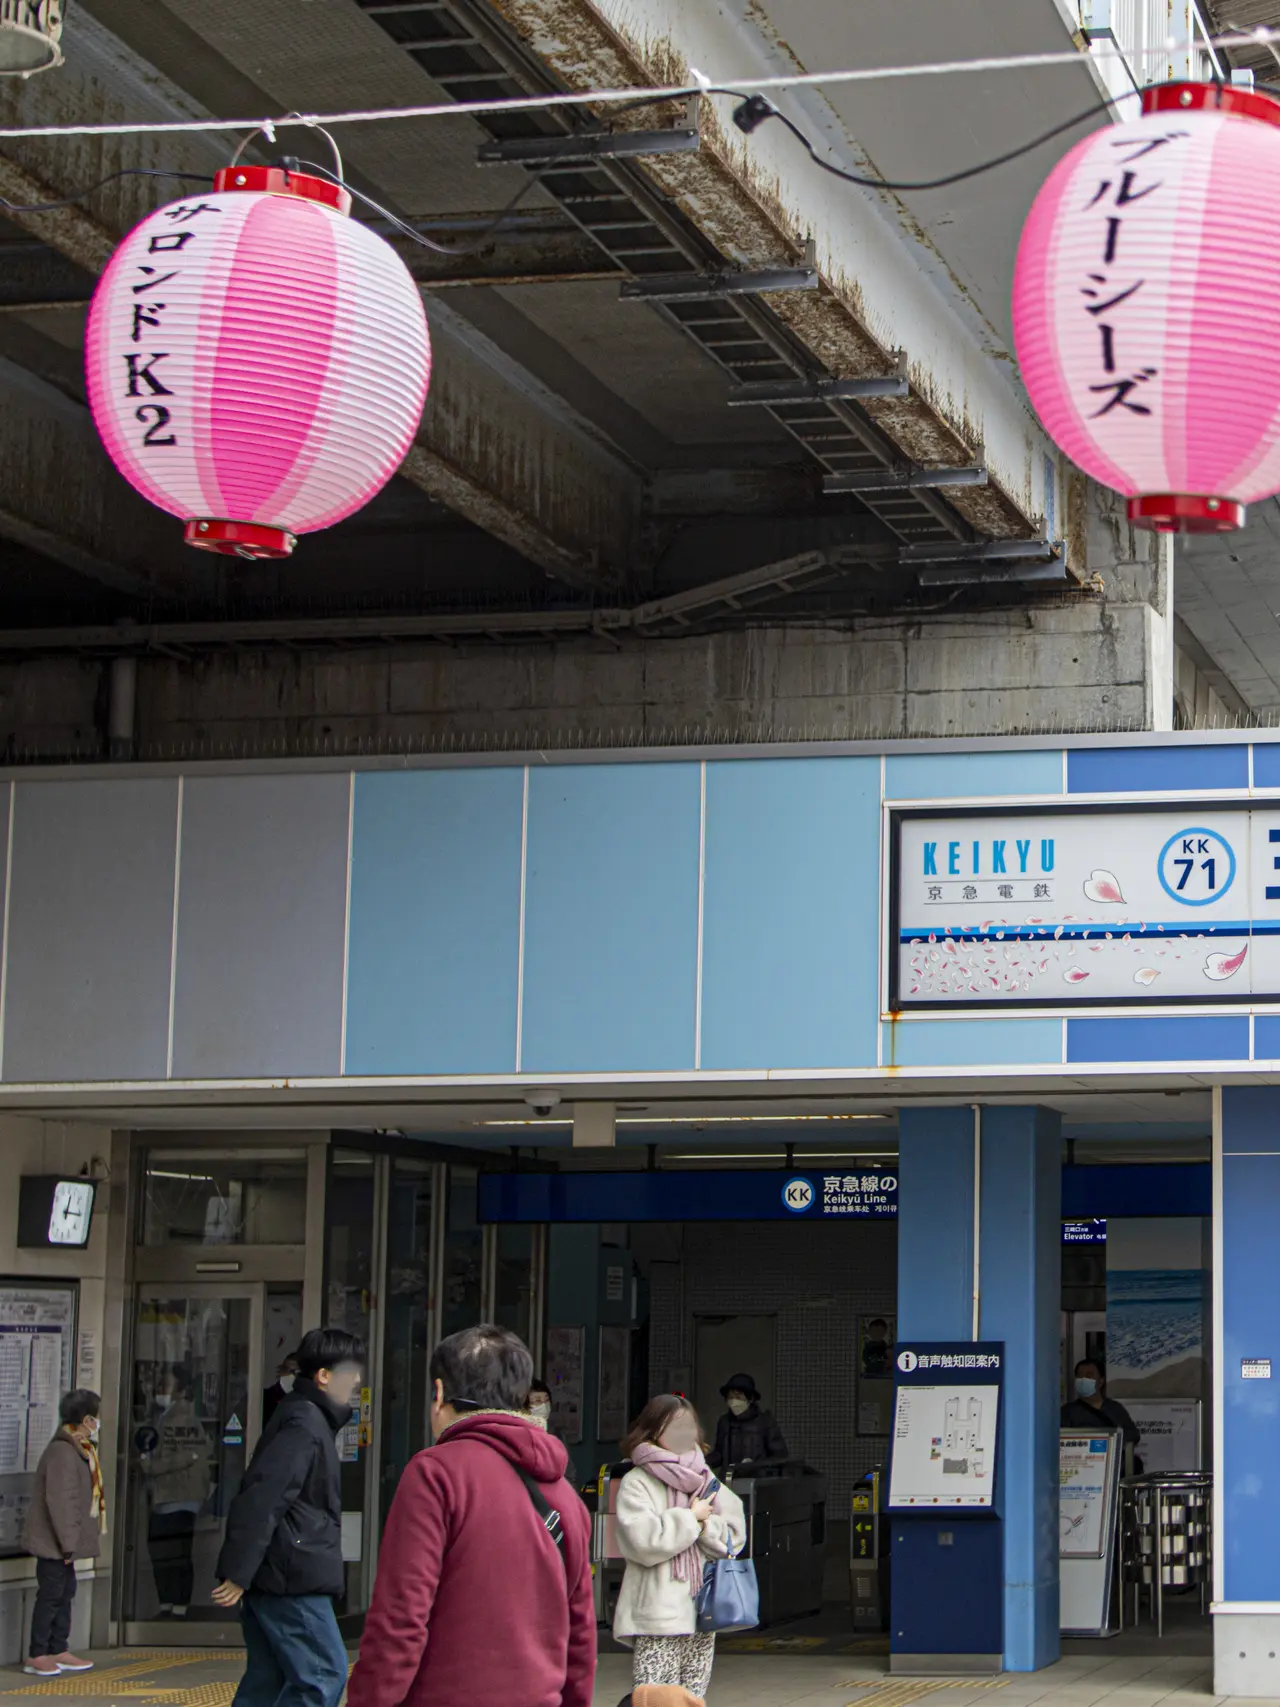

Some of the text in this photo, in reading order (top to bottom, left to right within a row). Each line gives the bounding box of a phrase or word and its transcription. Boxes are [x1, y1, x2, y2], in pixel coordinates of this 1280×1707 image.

[1079, 132, 1191, 420] ブルーシーズ
[122, 203, 222, 447] サロンドK2
[1182, 838, 1210, 854] KK
[923, 839, 1055, 875] KEIKYU
[1173, 858, 1216, 891] 71
[927, 883, 1051, 900] 京急電鉄
[823, 1175, 898, 1193] 京急線の
[787, 1188, 810, 1201] KK
[864, 1193, 887, 1204] Line
[917, 1354, 1000, 1369] 音声触知図案内
